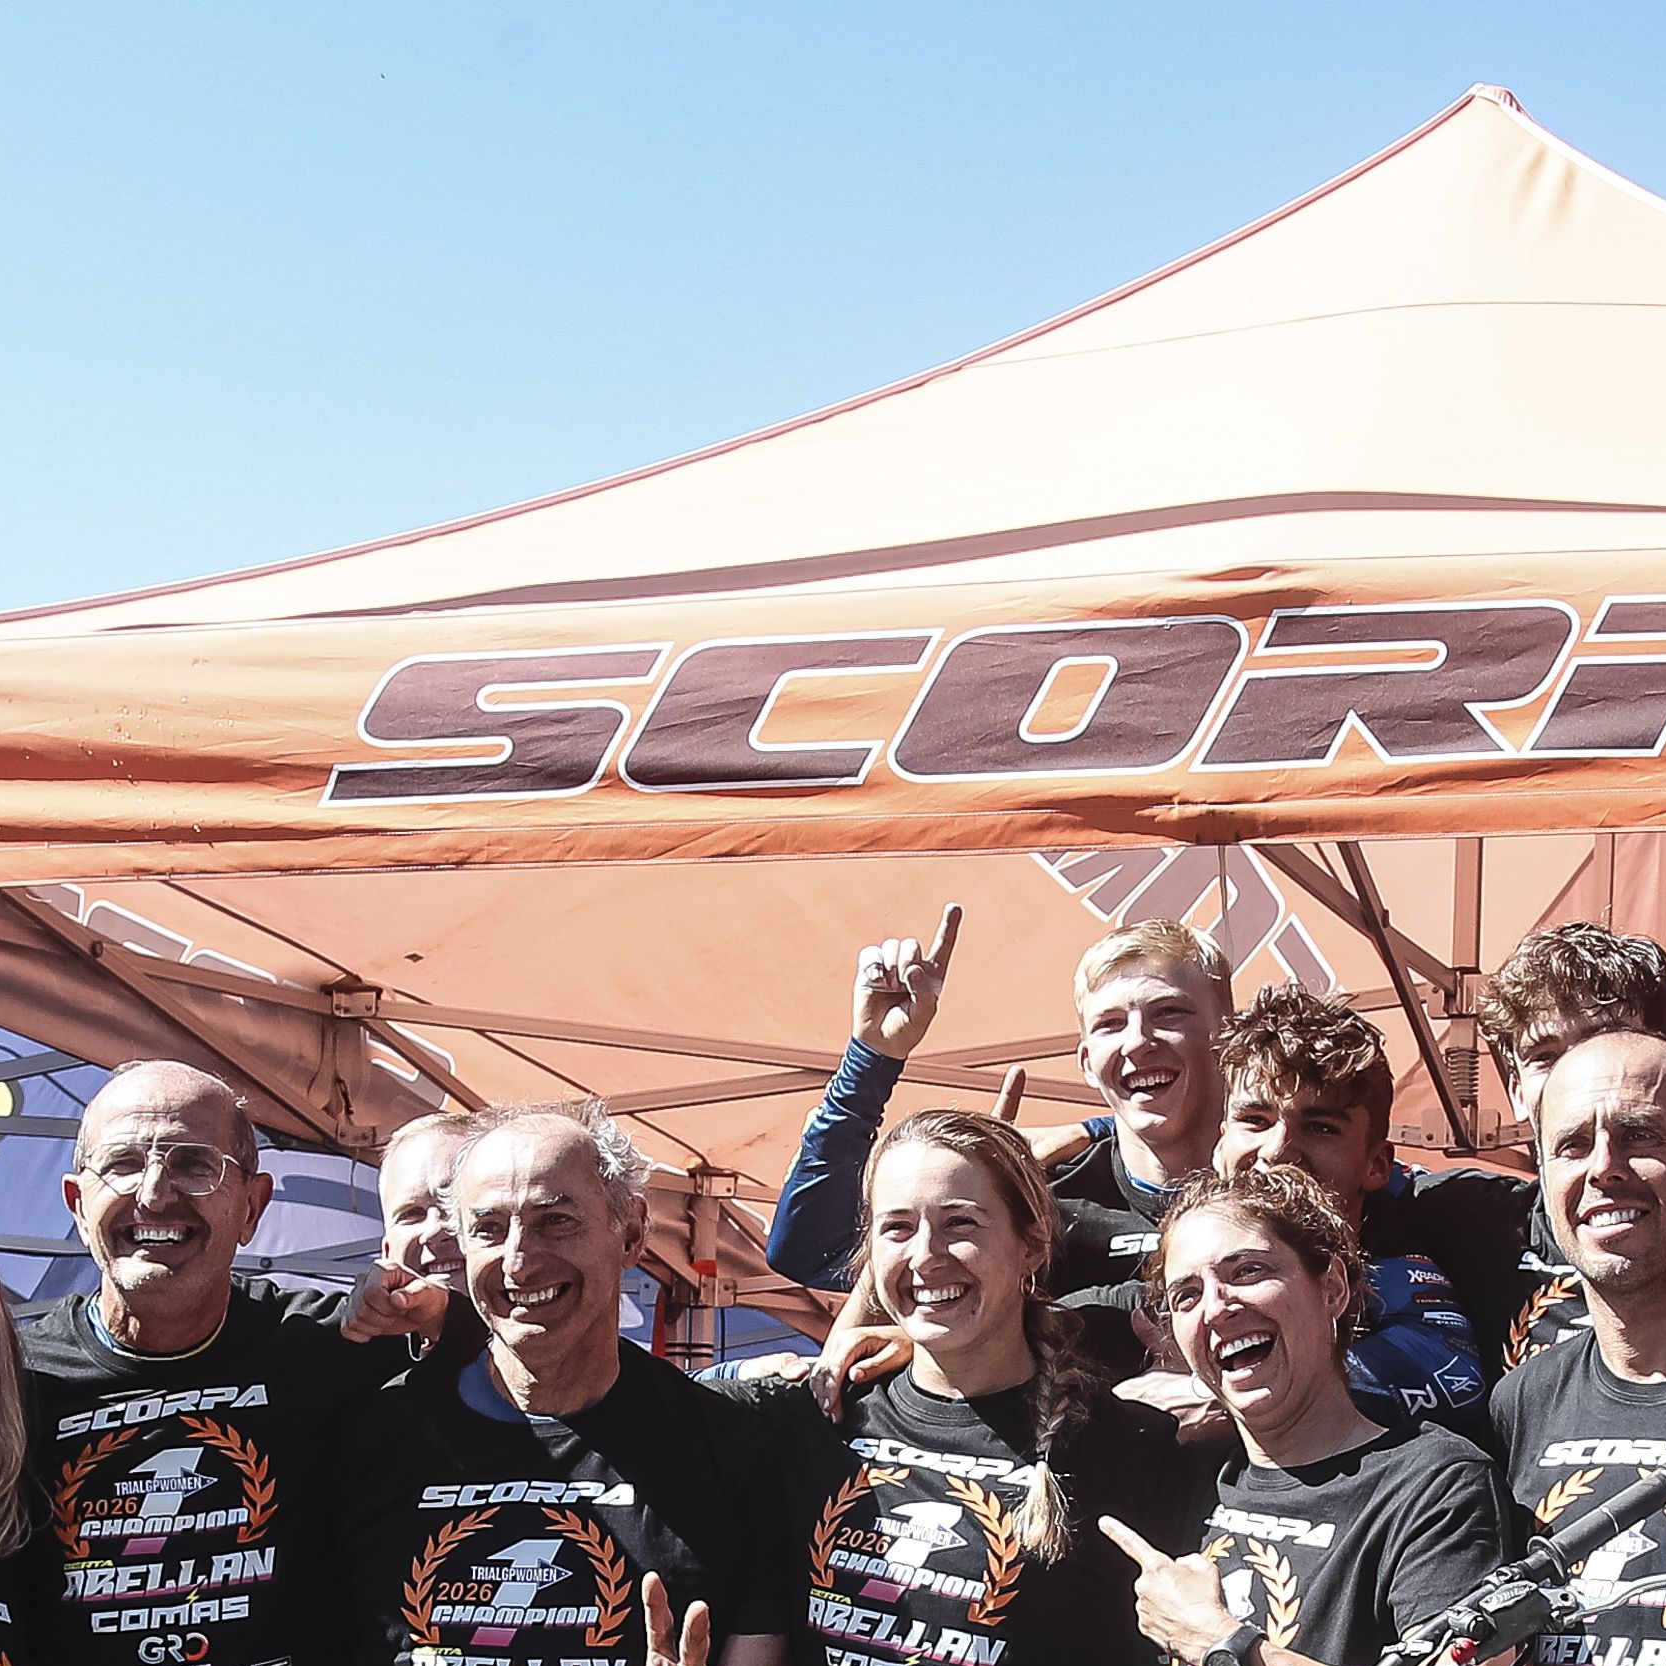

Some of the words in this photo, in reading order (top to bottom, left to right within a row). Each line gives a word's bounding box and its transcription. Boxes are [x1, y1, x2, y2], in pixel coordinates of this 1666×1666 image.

[56, 1383, 269, 1440] SCORPA
[848, 1437, 1037, 1487] SCORPA
[114, 1475, 202, 1496] TRIALGPWOMEN
[418, 1481, 635, 1508] SCORPA
[83, 1498, 138, 1518] 2026
[79, 1507, 249, 1540] CHAMPION
[836, 1527, 891, 1554] 2026
[61, 1547, 276, 1600] ABELLAN
[470, 1566, 558, 1583] TRIALGPWOMEN
[828, 1549, 987, 1603] CHAMPION
[436, 1582, 493, 1601] 2026
[91, 1595, 250, 1634] COMAS
[431, 1604, 600, 1630] CHAMPION
[137, 1632, 209, 1665] GRO
